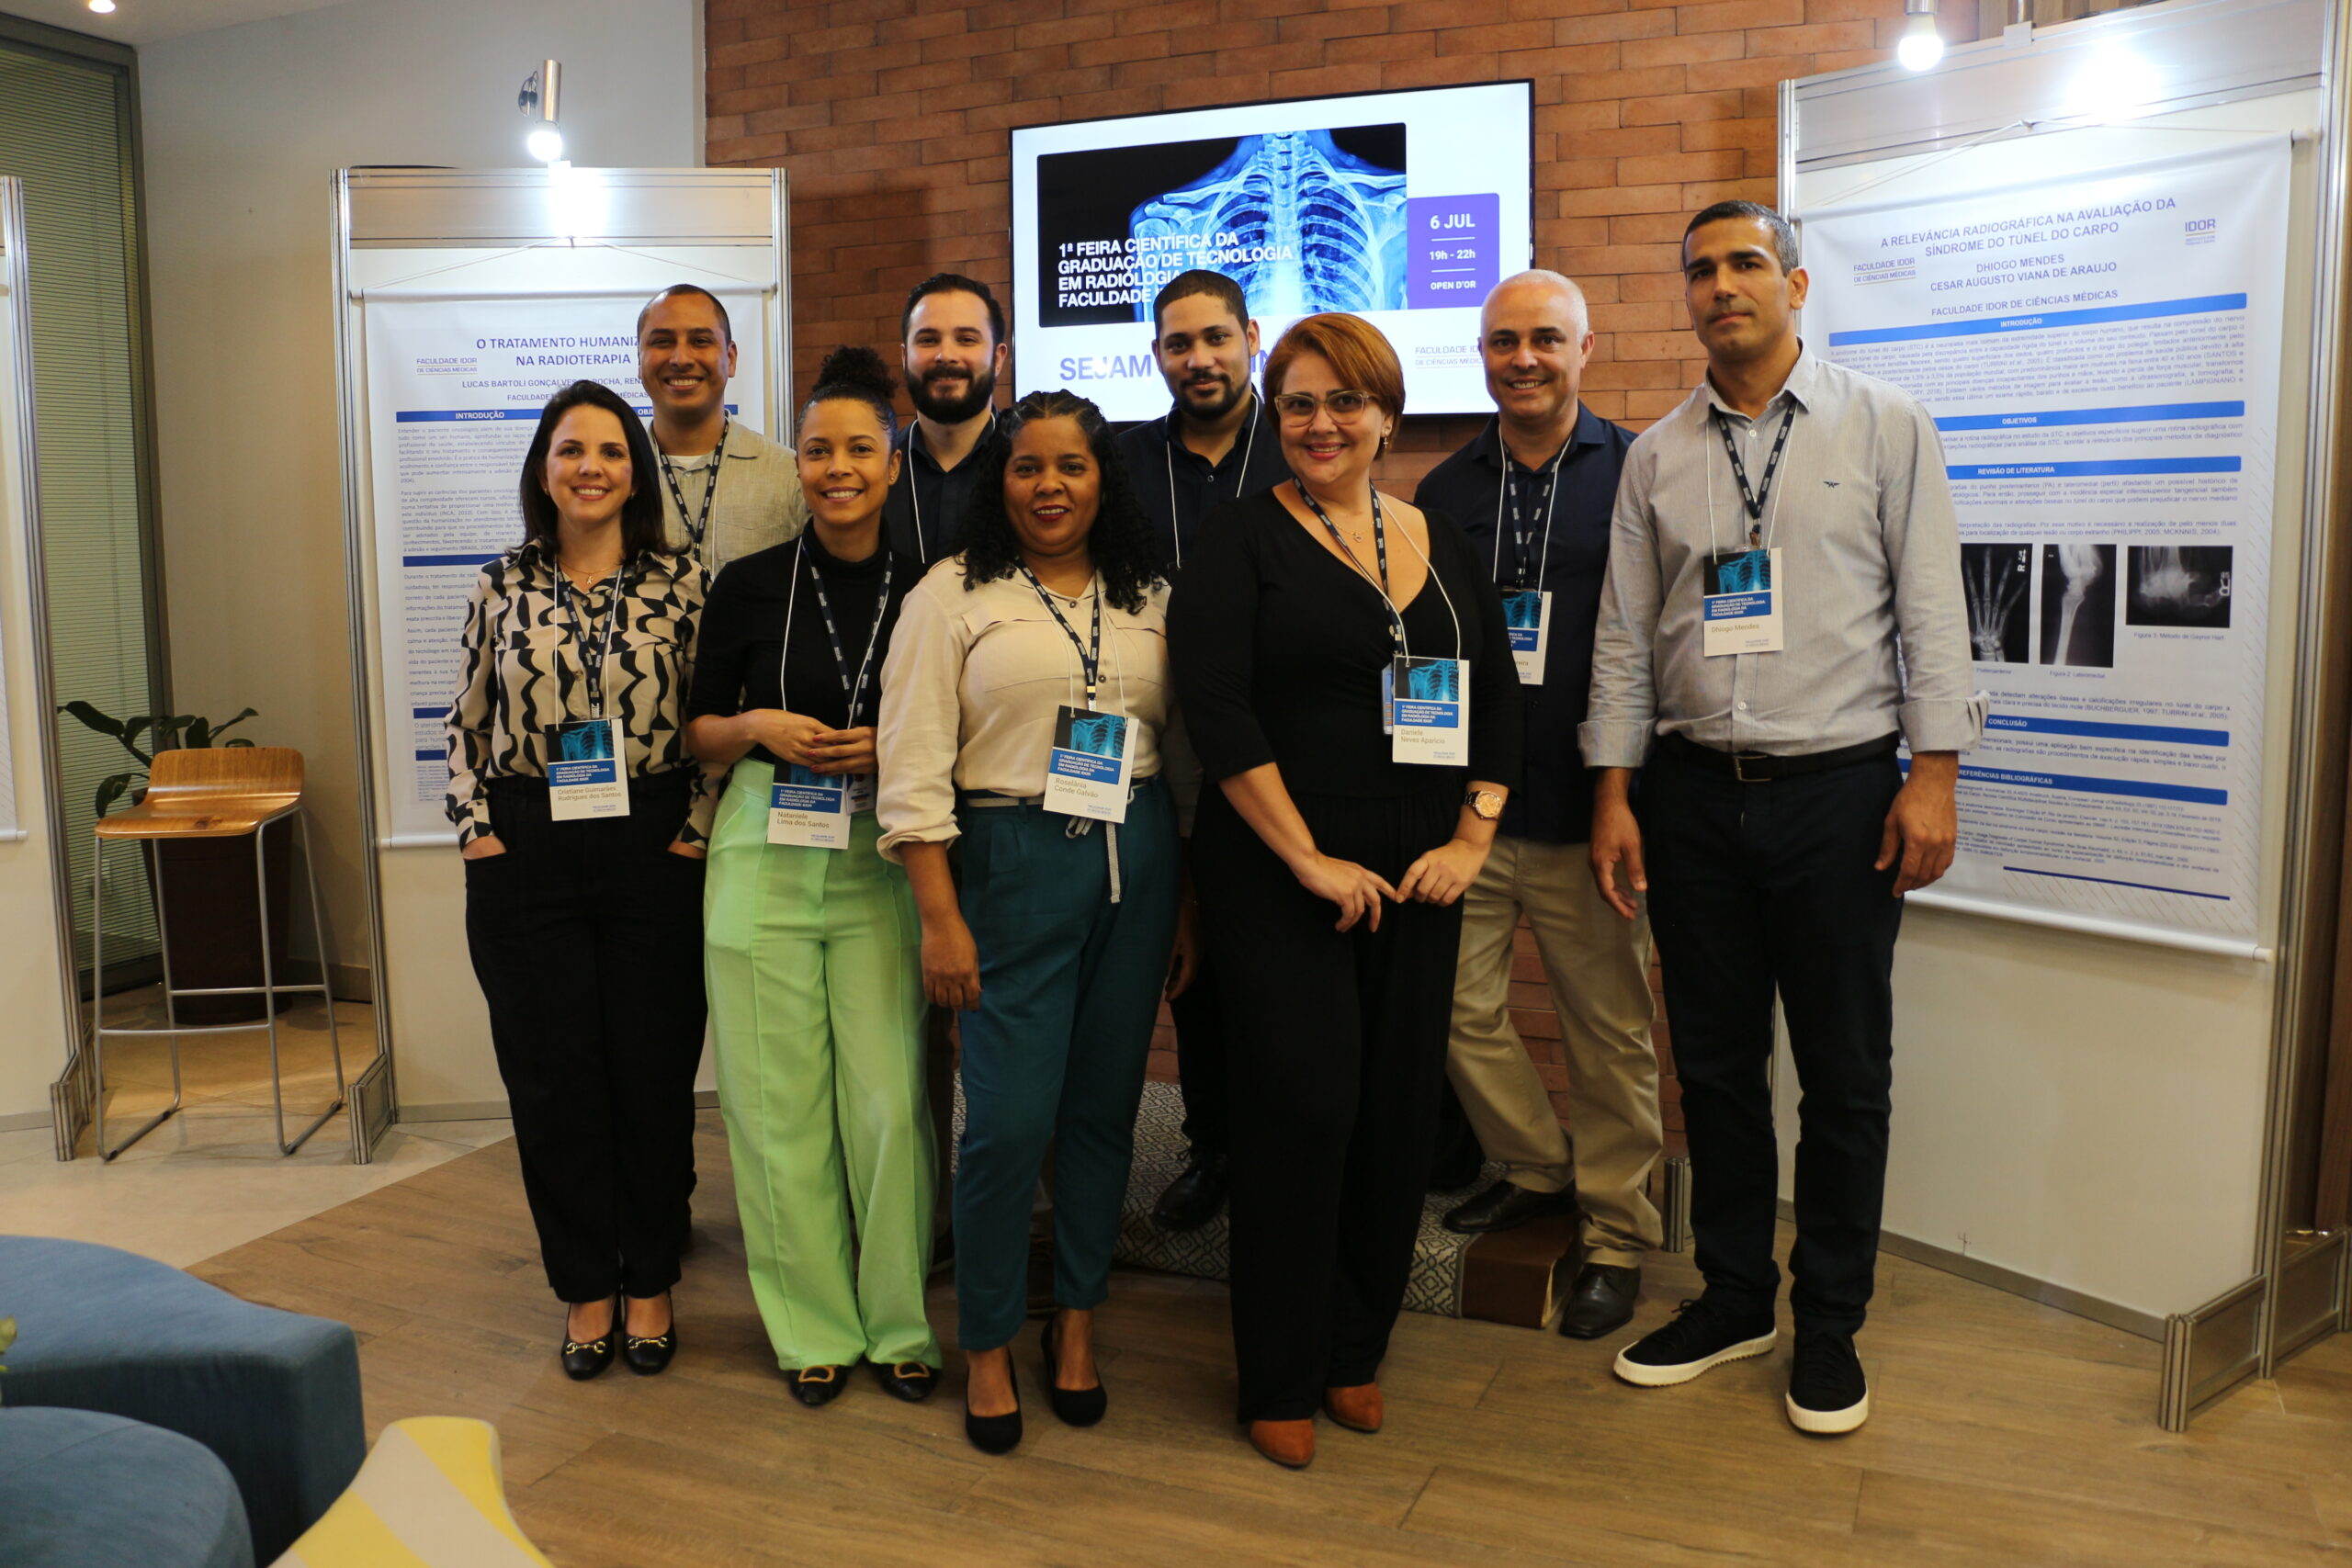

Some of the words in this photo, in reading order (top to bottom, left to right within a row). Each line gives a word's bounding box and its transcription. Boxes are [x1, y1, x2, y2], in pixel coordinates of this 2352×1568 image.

[1430, 215, 1440, 230] 6
[1444, 213, 1476, 230] JUL
[1881, 238, 1888, 248] A
[1891, 228, 1961, 246] RELEVÂNCIA
[1962, 215, 2054, 236] RADIOGRÁFICA
[2056, 212, 2074, 224] NA
[2076, 199, 2153, 221] AVALIAÇÃO
[2156, 197, 2177, 210] DA
[2185, 219, 2216, 232] IDOR
[1077, 239, 1122, 257] FEIRA
[1125, 232, 1213, 254] CIENTÍFICA
[1216, 231, 1239, 247] DA
[1925, 239, 1984, 257] SÍNDROME
[1987, 237, 2005, 249] DO
[2008, 230, 2048, 246] TÚNEL
[2051, 228, 2070, 241] DO
[2073, 221, 2120, 238] CARPO
[1058, 254, 1158, 275] GRADUAÇÃO
[1161, 253, 1183, 268] DE
[1186, 245, 1294, 266] TECNOLOGIA
[1429, 250, 1448, 261] 19h
[1457, 249, 1476, 260] 22h
[1853, 260, 1895, 272] FACULDADE
[1897, 257, 1916, 266] IDOR
[1976, 259, 2018, 273] DHIOGO
[2019, 254, 2065, 268] MENDES
[1058, 276, 1082, 291] EM
[1085, 270, 1180, 289] RADIOLOGIA
[1930, 279, 1964, 292] CESAR
[1965, 274, 2015, 288] AUGUSTO
[2018, 270, 2050, 282] VIANA
[2052, 267, 2067, 278] DE
[2070, 262, 2118, 276] ARAUJO
[1430, 281, 1454, 290] OPEN
[1455, 280, 1476, 289] D'OR
[1058, 289, 1152, 309] FACULDADE
[1931, 303, 1984, 317] FACULDADE
[1985, 300, 2008, 310] IDOR
[2010, 299, 2023, 309] DE
[2025, 295, 2070, 308] CIÊNCIAS
[2073, 289, 2119, 302] MÉDICAS
[2000, 317, 2043, 328] INTRODUÇÃO
[476, 339, 487, 349] O
[490, 337, 577, 349] TRATAMENTO
[579, 336, 639, 348] HUMANIZ
[1415, 345, 1467, 355] FACULDADE
[1470, 345, 1479, 354] ID
[515, 355, 535, 367] NA
[538, 354, 631, 366] RADIOTERAPIA
[1459, 356, 1484, 365] MÉDIC
[492, 379, 526, 388] BARTOLI
[455, 411, 505, 420] INTRODUÇÃO
[2001, 417, 2038, 425] OBJETIVOS
[1988, 718, 2028, 728] CONCLUSÃO
[1959, 770, 2000, 779] REFERÊNCIAS
[2000, 773, 2053, 785] BIBLIOGRÁFICAS
